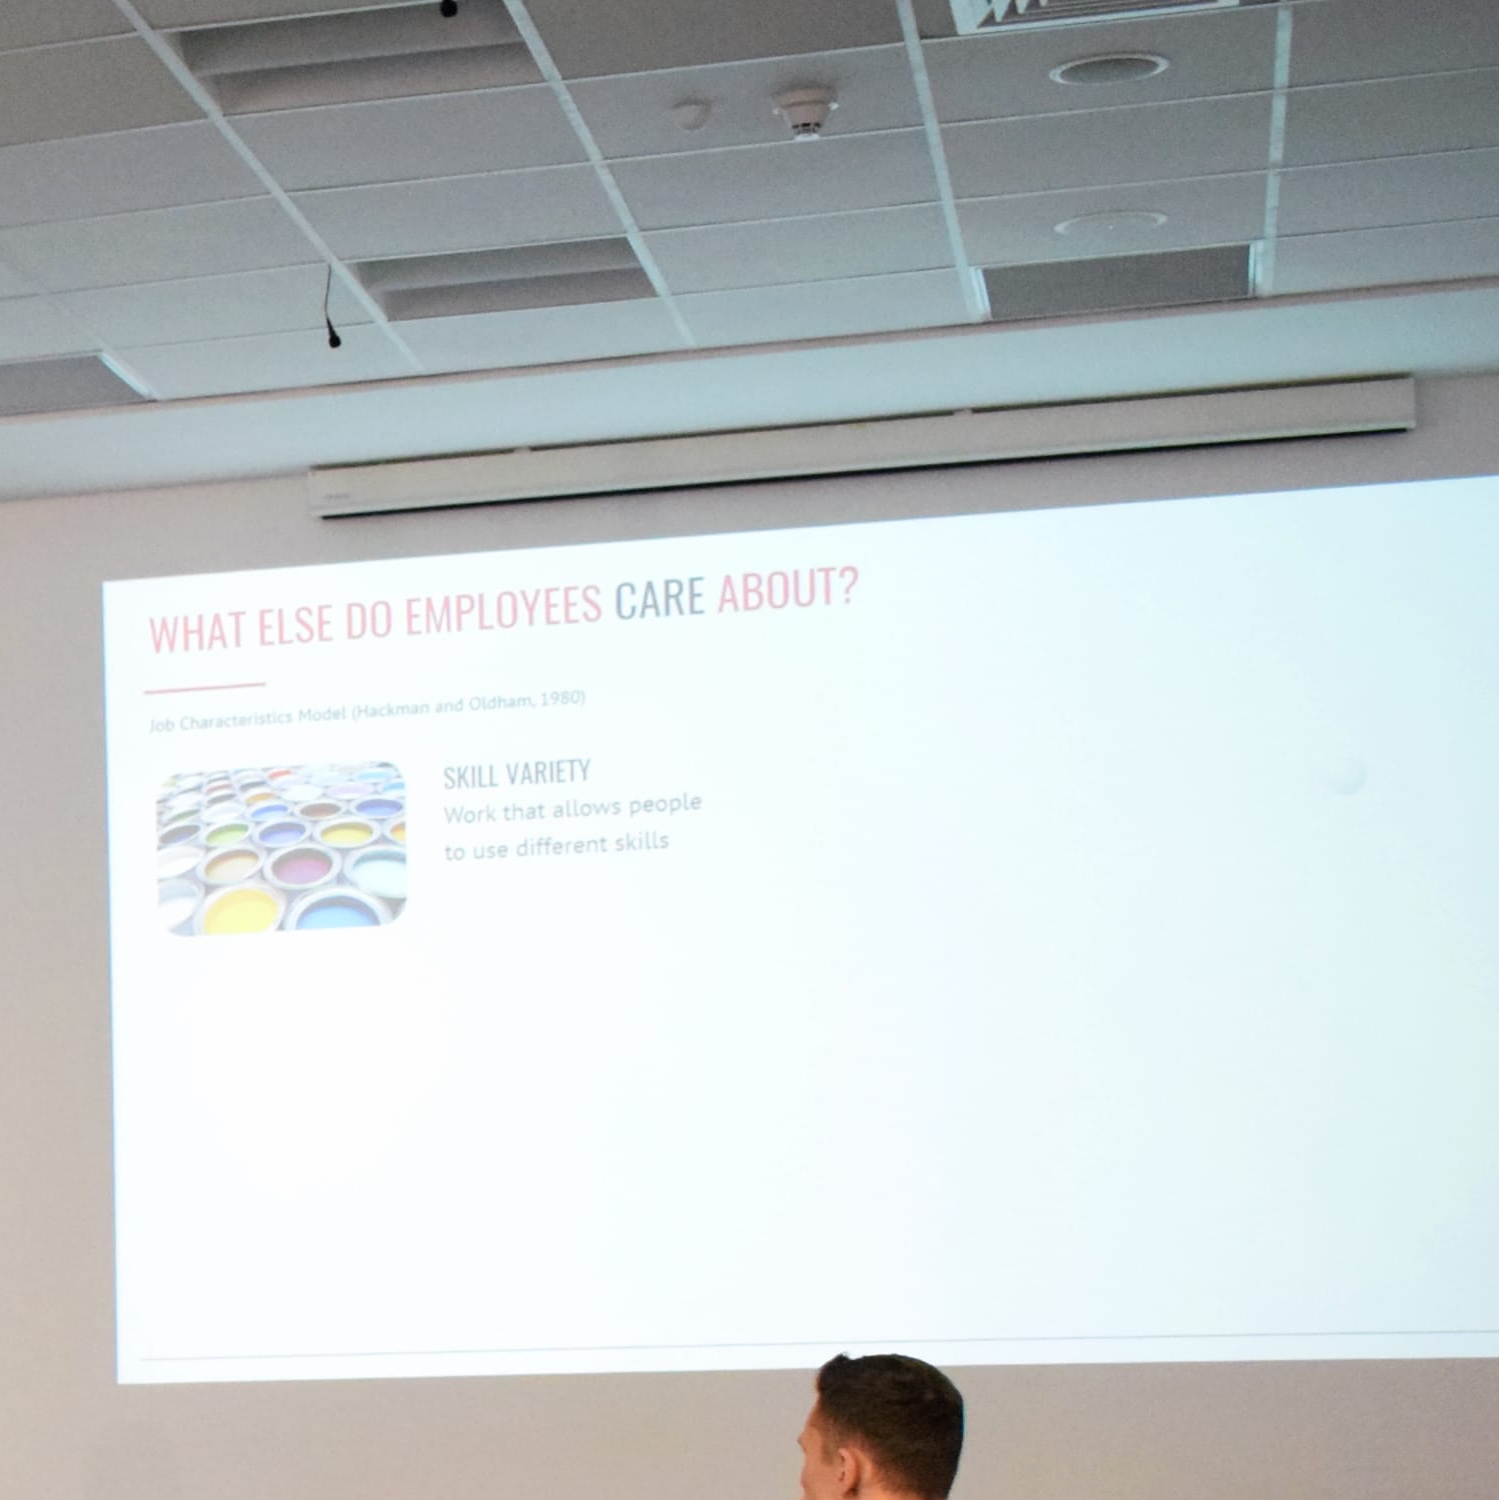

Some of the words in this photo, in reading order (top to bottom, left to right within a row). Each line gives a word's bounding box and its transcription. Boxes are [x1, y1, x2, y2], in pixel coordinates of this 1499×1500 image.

[149, 611, 246, 654] WHAT
[259, 604, 334, 647] ELSE
[346, 600, 392, 640] DO
[406, 585, 602, 636] EMPLOYEES
[614, 576, 705, 620] CARE
[718, 566, 859, 613] ABOUT?
[149, 718, 175, 733] Job
[179, 710, 294, 731] Characteristics
[298, 705, 347, 722] Model
[351, 703, 430, 722] (Hackman
[435, 697, 465, 714] and
[469, 695, 537, 711] Oldham,
[541, 688, 586, 707] 1980)
[443, 764, 499, 790] SKILL
[506, 758, 592, 786] VARIETY
[443, 803, 497, 824] Work
[502, 802, 546, 822] that
[552, 799, 622, 818] allows
[629, 792, 702, 818] people
[443, 845, 467, 862] to
[473, 844, 509, 860] use
[516, 835, 609, 857] different
[615, 830, 670, 852] skills
